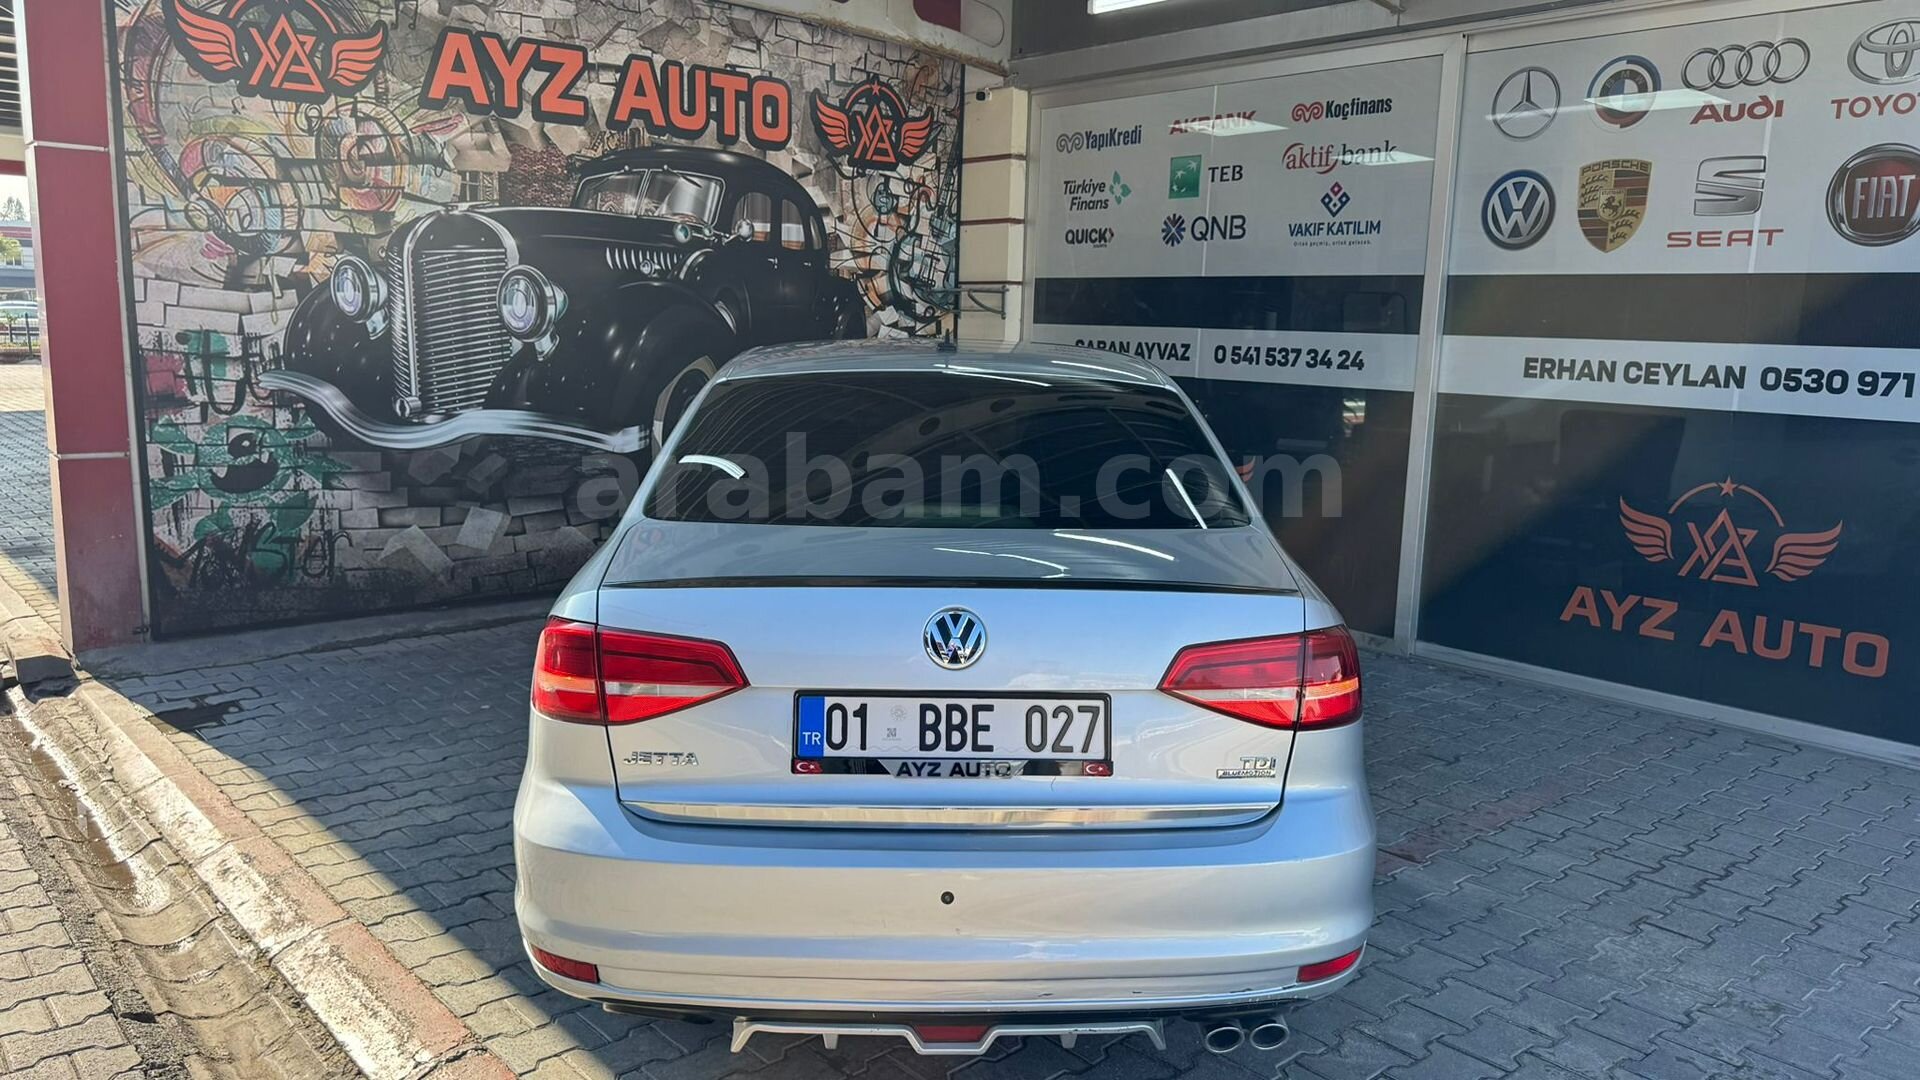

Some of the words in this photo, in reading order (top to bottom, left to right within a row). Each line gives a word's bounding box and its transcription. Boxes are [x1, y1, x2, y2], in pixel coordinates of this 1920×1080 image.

[425, 29, 587, 119] AYZ
[611, 56, 791, 145] AUTO
[1325, 97, 1393, 120] Koçfinans
[1830, 92, 1920, 120] TOYO
[1208, 165, 1244, 183] TEB
[1580, 160, 1650, 177] PORSCHE
[1063, 178, 1106, 197] Türkiye
[1851, 174, 1916, 219] FIAT
[1069, 196, 1109, 211] Finans
[1065, 227, 1108, 245] QUICK
[1190, 214, 1246, 242] QNB
[1288, 222, 1325, 237] VAKIF
[1326, 220, 1381, 236] KATILIM
[1667, 228, 1784, 248] SEAT
[1135, 341, 1191, 362] AYVAZ
[1213, 344, 1227, 364] 0
[1230, 346, 1261, 366] 541
[1264, 346, 1302, 367] 537
[1305, 348, 1333, 369] 34
[1336, 349, 1365, 371] 24
[1523, 357, 1617, 383] ERHAN
[1622, 360, 1747, 389] CEYLAN
[1760, 366, 1849, 395] 0530
[1856, 370, 1916, 398] 971
[1560, 586, 1679, 641] AYZ
[1700, 608, 1890, 679] AUTO
[802, 731, 821, 746] TR
[825, 702, 868, 752] 01
[919, 703, 995, 752] BBE
[1025, 704, 1101, 753] 027
[623, 750, 699, 766] JETTA
[1239, 756, 1276, 770] TDI
[896, 761, 942, 777] AYZ
[949, 761, 1011, 777] AUTO
